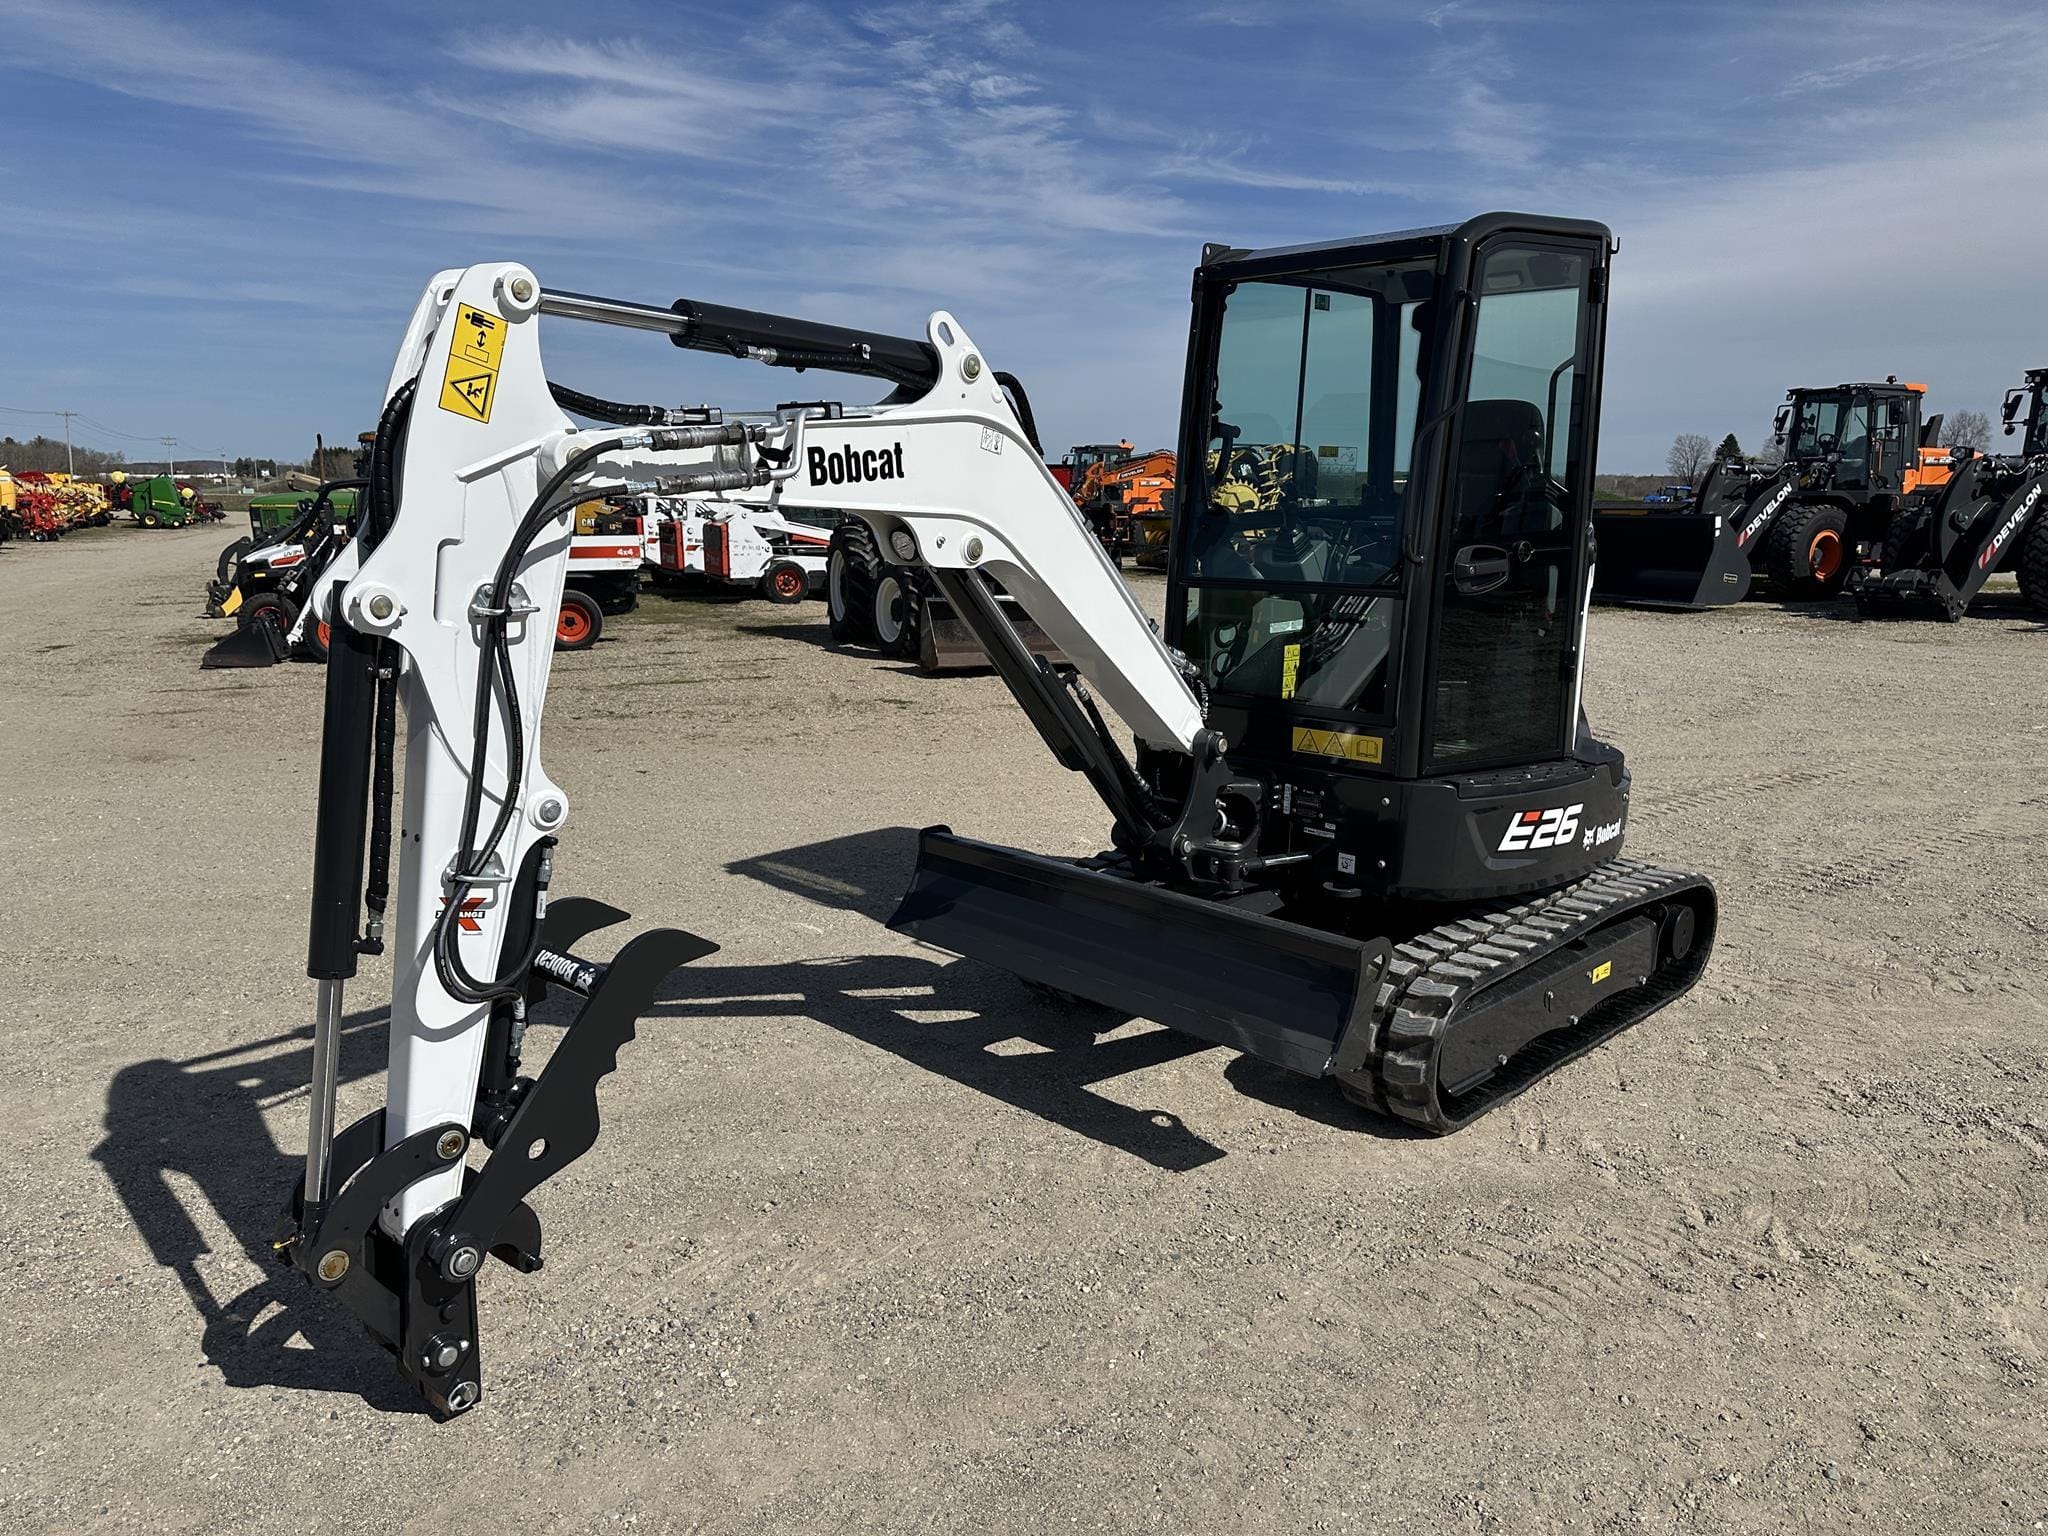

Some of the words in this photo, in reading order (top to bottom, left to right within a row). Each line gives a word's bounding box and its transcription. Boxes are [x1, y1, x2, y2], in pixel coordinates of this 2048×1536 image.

[807, 441, 905, 487] Bobcat
[581, 518, 596, 527] CAT
[1745, 482, 1793, 536] DEVELON
[1993, 483, 2042, 549] DEVELON
[617, 548, 634, 556] 4x4
[1497, 803, 1584, 851] E26
[1595, 817, 1622, 846] Bobcat
[534, 949, 580, 982] Bobcat
